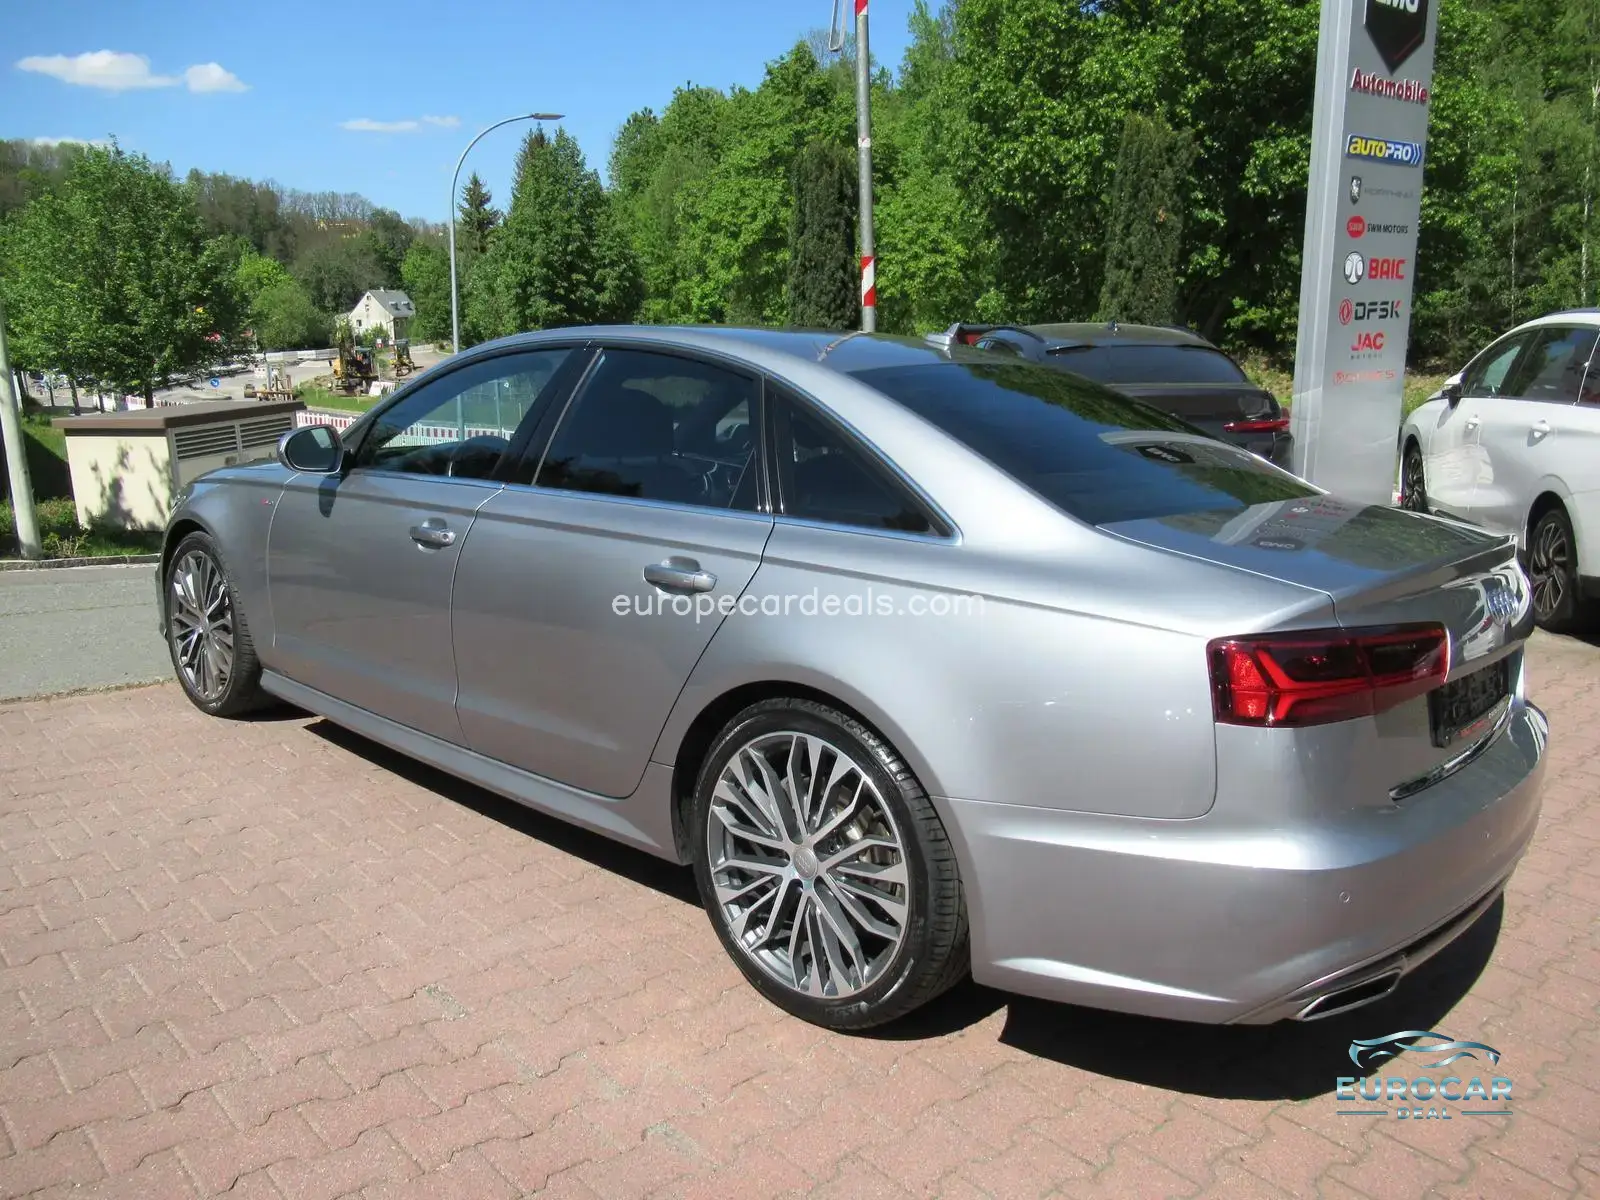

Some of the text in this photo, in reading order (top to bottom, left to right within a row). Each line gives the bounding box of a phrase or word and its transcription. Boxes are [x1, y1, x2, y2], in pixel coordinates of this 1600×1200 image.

[1351, 68, 1428, 104] Automobile
[1367, 223, 1408, 234] SWM MOTORS
[1368, 258, 1406, 280] BAIC
[1354, 301, 1402, 321] DFSK
[1351, 332, 1384, 351] JAC
